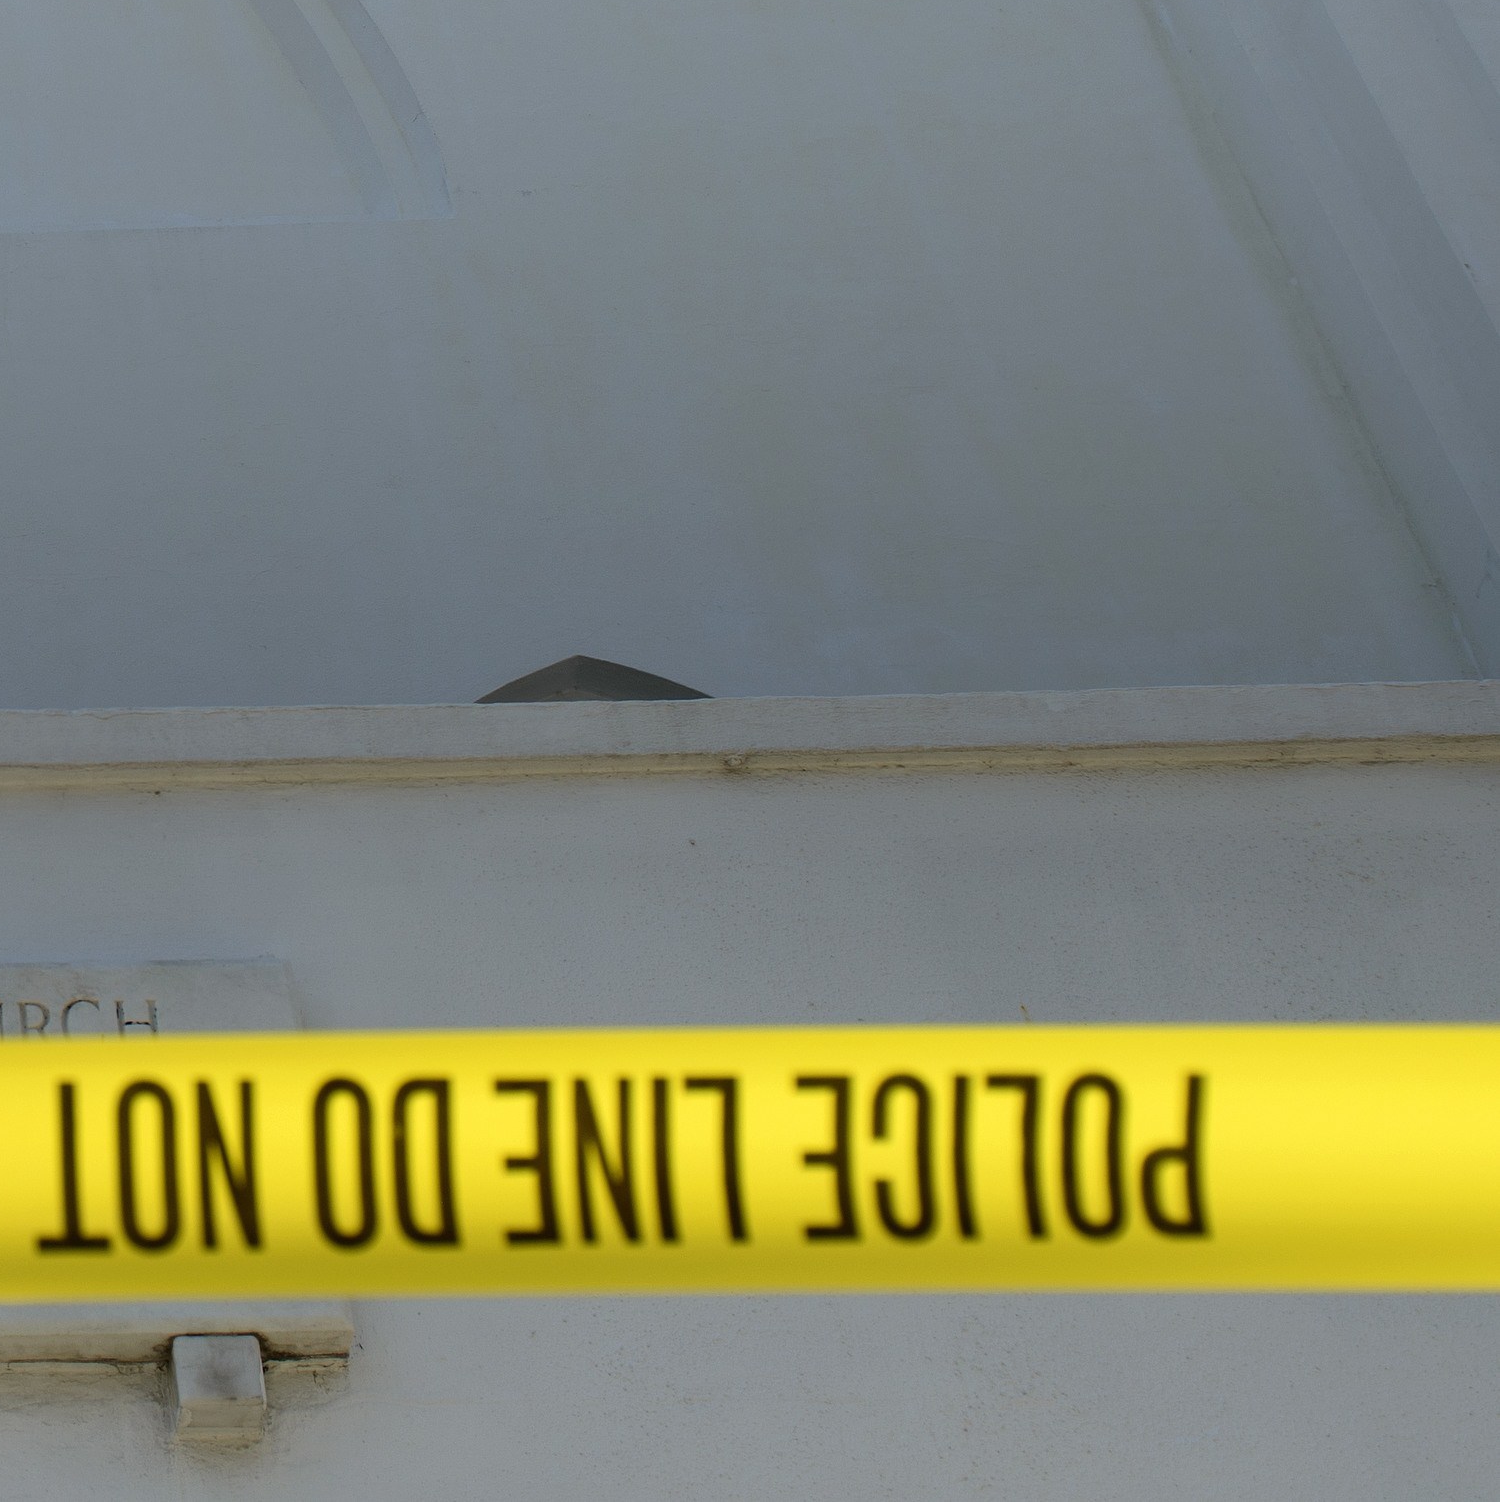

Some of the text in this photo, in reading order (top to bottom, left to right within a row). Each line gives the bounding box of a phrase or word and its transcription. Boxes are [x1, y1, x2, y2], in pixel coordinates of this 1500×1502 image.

[35, 1078, 265, 1255] NOT
[310, 1076, 461, 1251] DO
[493, 1076, 750, 1247] LINE
[793, 1073, 1213, 1245] POLICE
